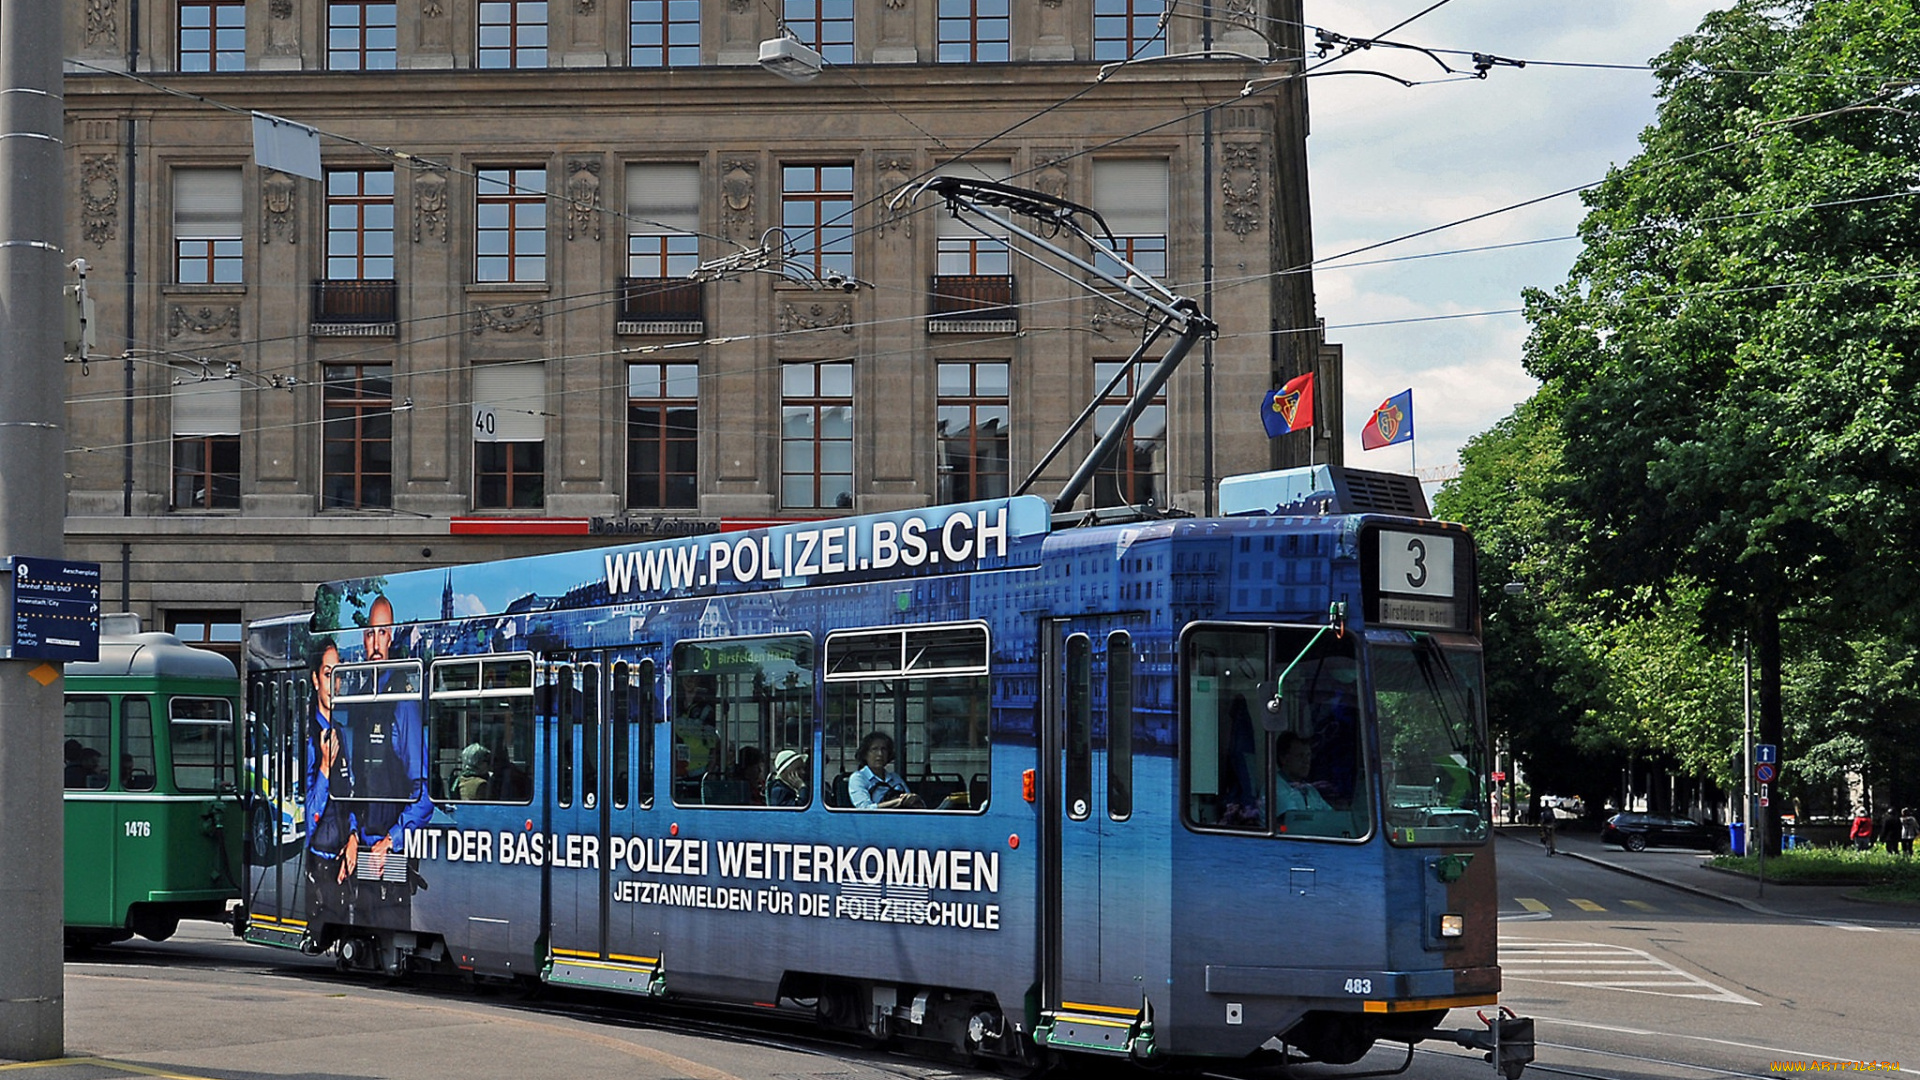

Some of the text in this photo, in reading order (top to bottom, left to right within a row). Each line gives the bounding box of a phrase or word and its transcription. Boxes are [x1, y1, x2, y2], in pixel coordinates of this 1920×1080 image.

[475, 411, 496, 435] 40
[604, 508, 1008, 595] WWW.POLIZEI.BS.CH
[1406, 539, 1427, 588] 3
[702, 650, 712, 671] 3
[124, 821, 151, 837] 1476
[403, 828, 999, 893] MIT DER BASLER POLIZEI WEITERKOMMEN
[757, 885, 794, 915] FÜR
[799, 893, 831, 918] DIE
[836, 896, 1000, 930] POLIZEISCHULE
[1344, 978, 1372, 994] 483
